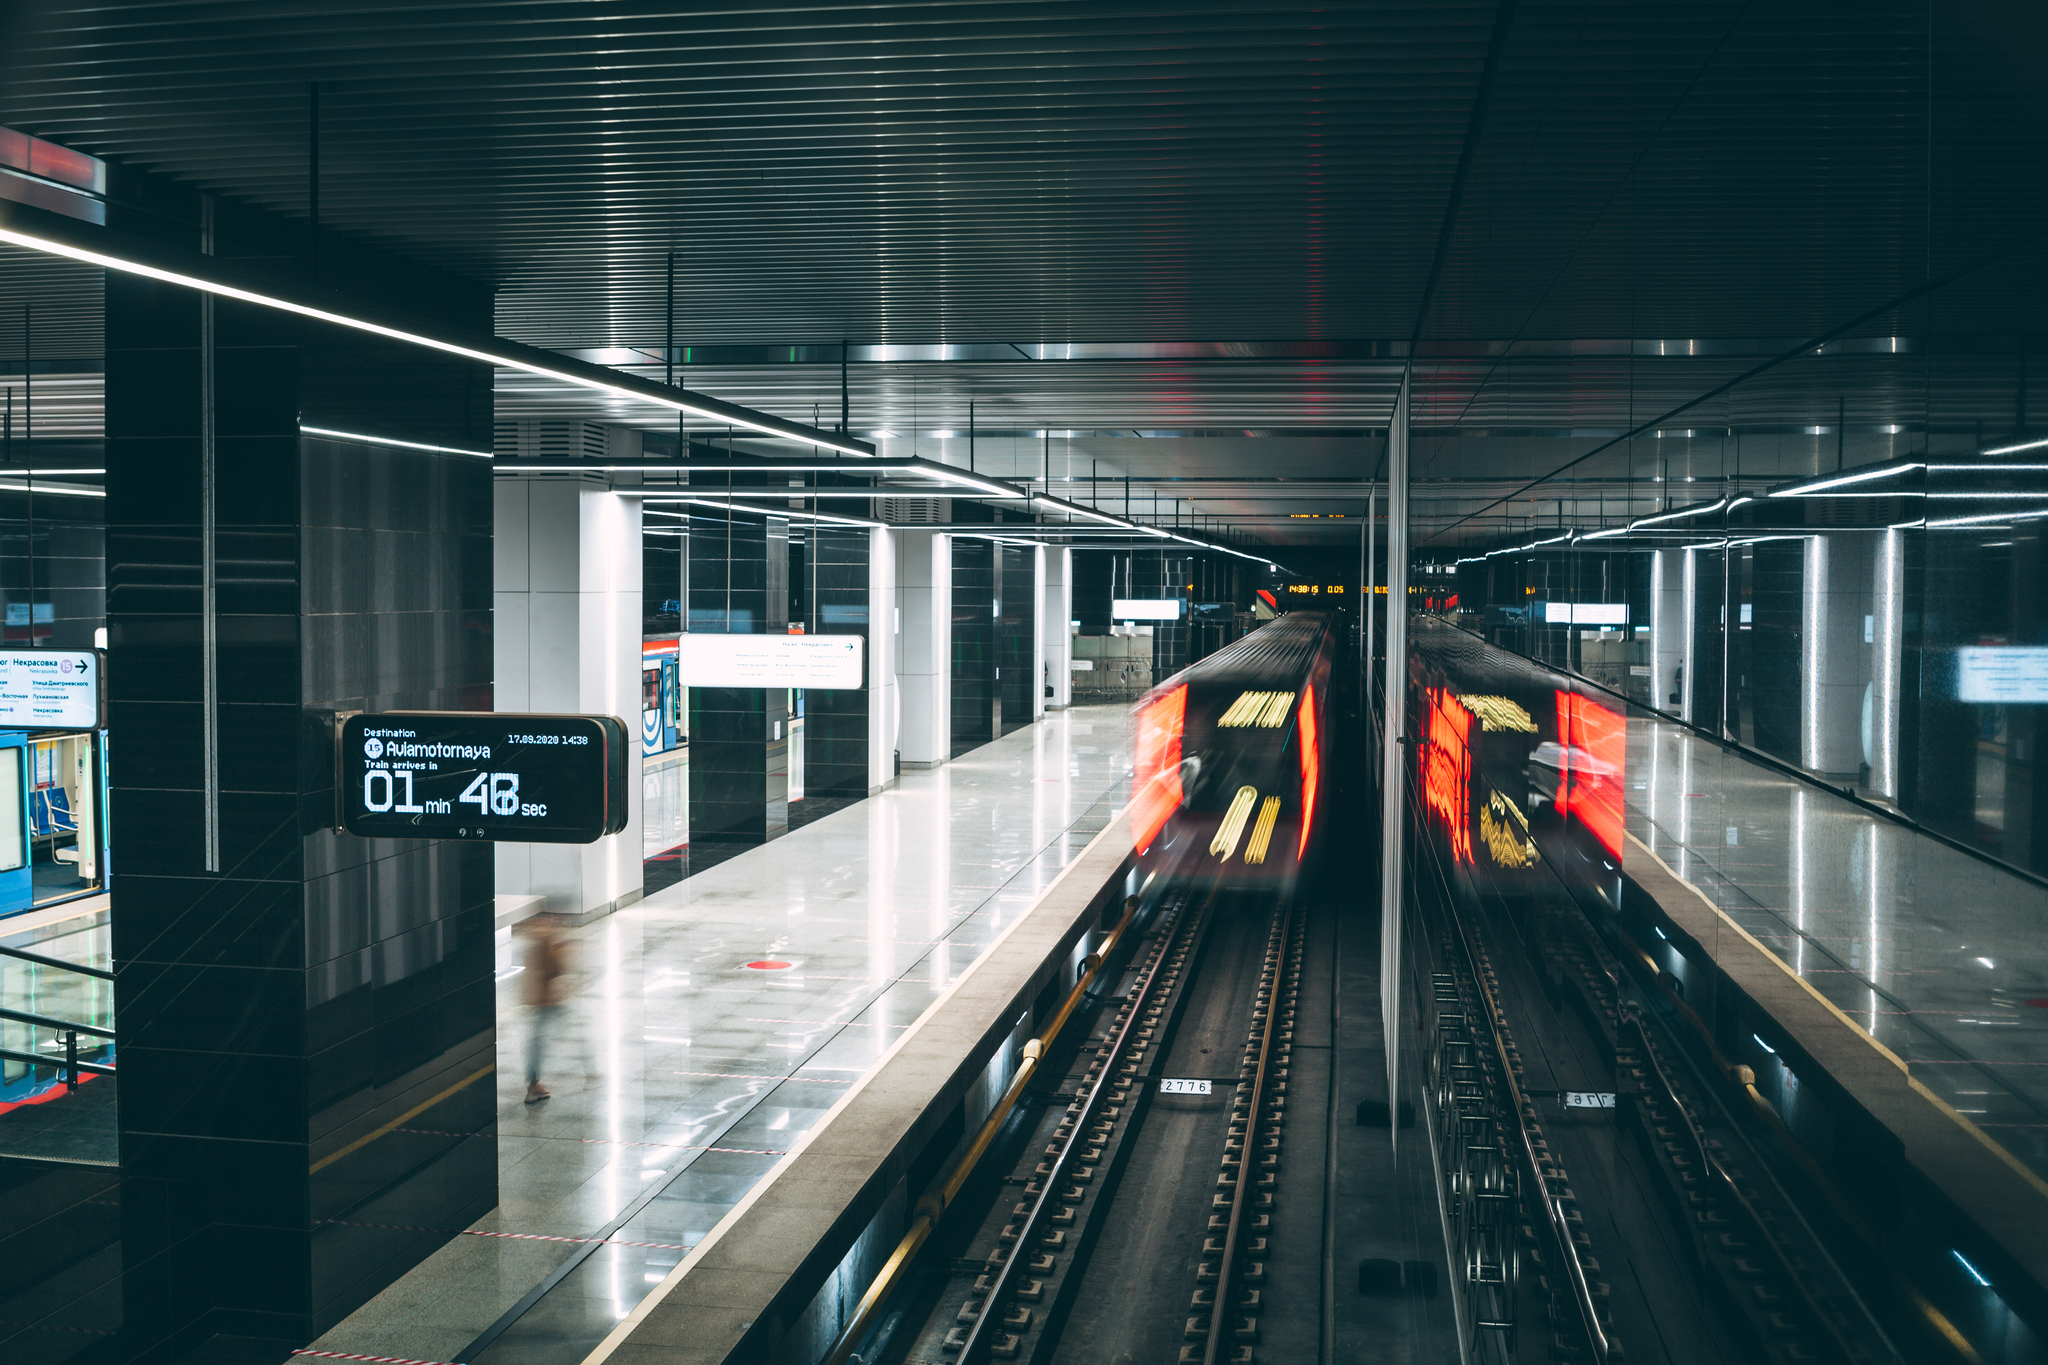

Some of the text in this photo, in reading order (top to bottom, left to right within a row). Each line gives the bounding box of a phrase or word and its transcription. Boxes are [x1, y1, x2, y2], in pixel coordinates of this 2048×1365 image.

[13, 658, 58, 668] Некрасовка
[364, 728, 416, 737] Destination
[508, 734, 589, 745] 17.09.2020 14:38
[386, 741, 491, 760] Aviamotornaya
[364, 760, 438, 770] Train arrives in
[364, 769, 424, 813] 01
[425, 798, 451, 814] min
[521, 803, 547, 817] sec
[1166, 1081, 1206, 1092] 2776
